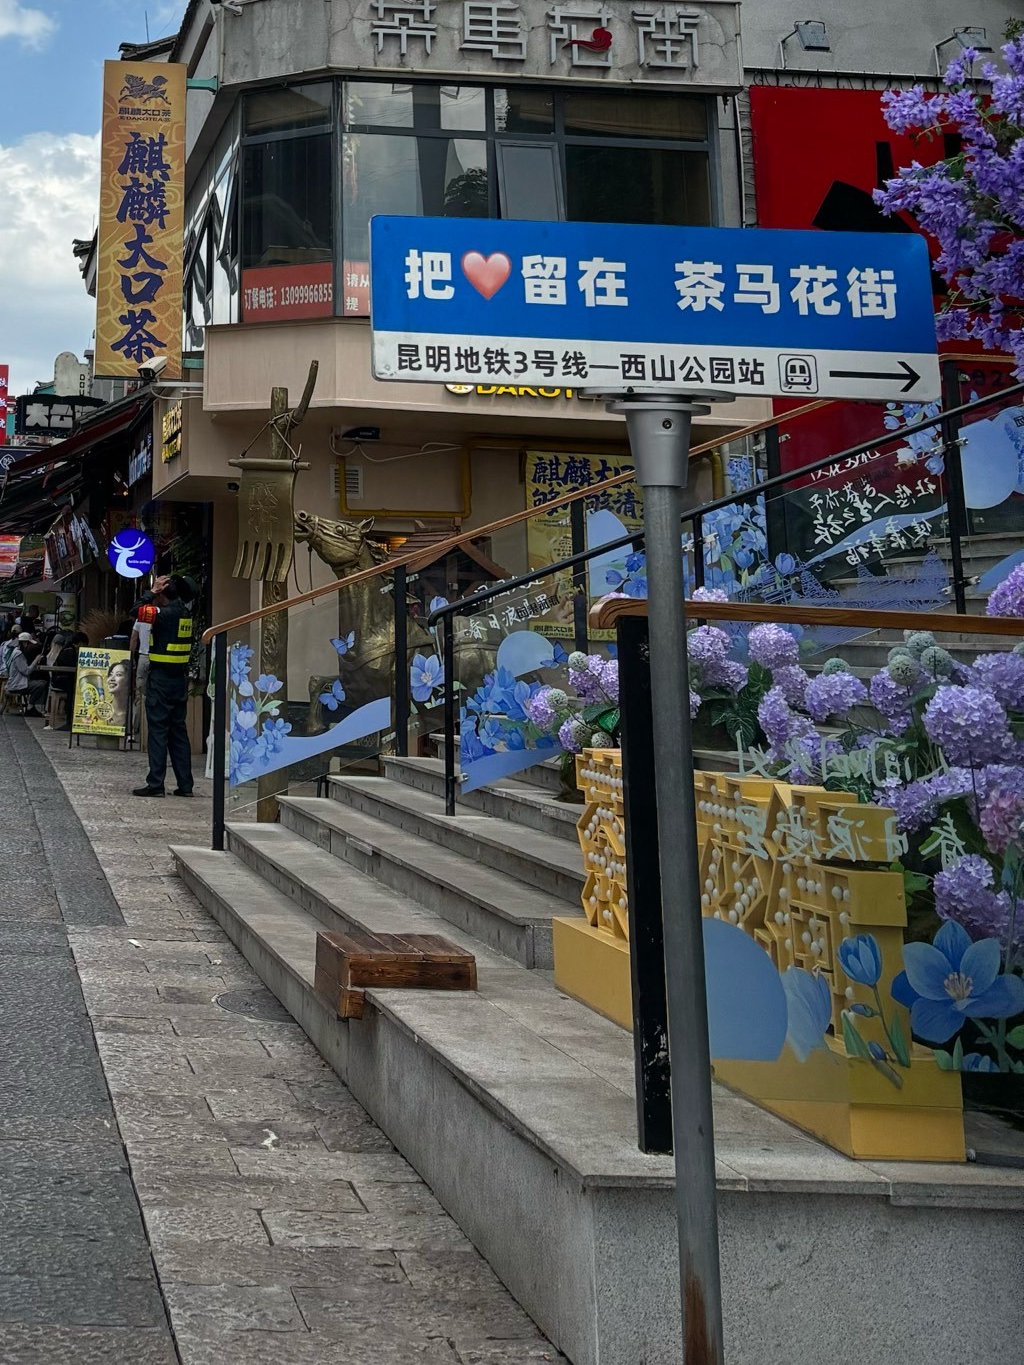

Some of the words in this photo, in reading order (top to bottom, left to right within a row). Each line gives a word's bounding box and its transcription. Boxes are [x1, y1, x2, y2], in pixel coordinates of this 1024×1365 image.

[110, 131, 172, 365] 麒麟大口茶
[405, 248, 455, 300] 把
[521, 253, 628, 307] 留在
[674, 260, 897, 320] 茶马花街
